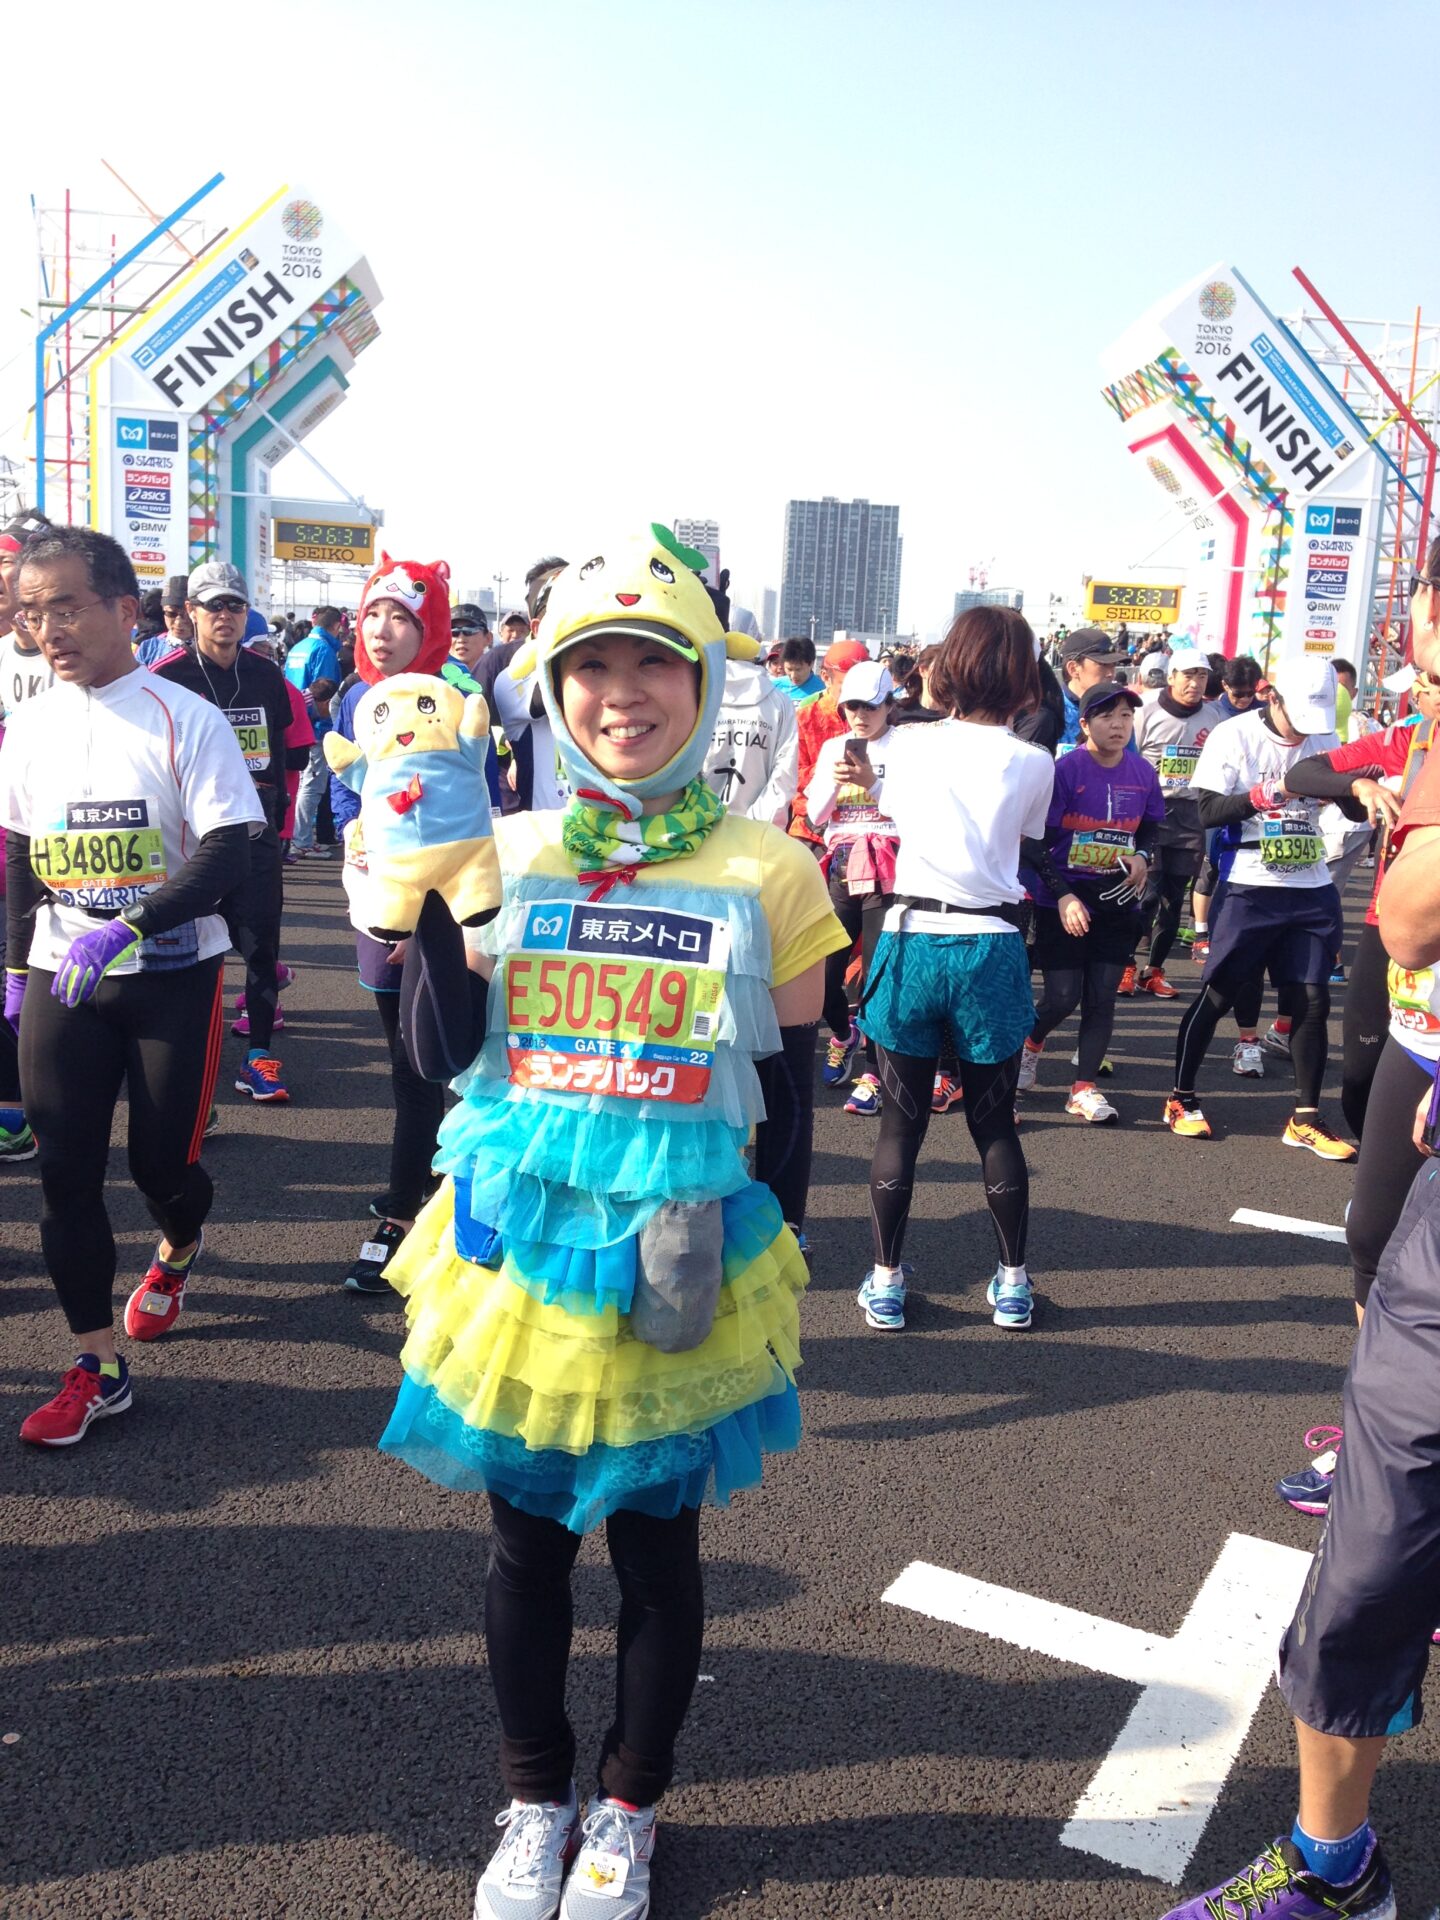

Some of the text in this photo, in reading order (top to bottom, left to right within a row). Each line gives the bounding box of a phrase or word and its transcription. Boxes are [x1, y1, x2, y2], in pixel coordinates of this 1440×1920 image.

[282, 245, 322, 256] TOKYO
[282, 256, 321, 264] MARATHON
[282, 264, 322, 279] 2016
[174, 301, 203, 331] MARATHON
[1197, 324, 1233, 335] TOKYO
[152, 271, 294, 408] FINISH
[1195, 342, 1231, 355] 2016
[1269, 354, 1285, 377] WORLD
[1286, 376, 1309, 405] MARATHON
[1216, 352, 1334, 492] FINISH
[136, 455, 173, 469] STARTS
[141, 491, 166, 501] asics
[141, 523, 167, 532] BMW
[296, 525, 369, 546] 5:26:31
[293, 545, 355, 562] SEIKO
[1320, 541, 1353, 552] STARTS
[1320, 573, 1344, 582] asics
[1109, 588, 1175, 606] 5:26:31
[1106, 607, 1162, 621] SEIKO
[1317, 603, 1341, 611] BMW
[71, 807, 142, 823] 東京メトロ
[1284, 823, 1316, 832] 東京メトロ
[1095, 832, 1127, 842] 東京メトロ
[33, 834, 143, 876] H34806
[1262, 838, 1317, 860] K83949
[110, 879, 116, 887] 2
[579, 918, 701, 952] 東京メトロ
[508, 960, 687, 1038] E50549
[521, 1036, 546, 1049] 2016
[575, 1039, 615, 1055] GATE
[689, 1051, 708, 1065] 22
[529, 1054, 676, 1097] ランチパック
